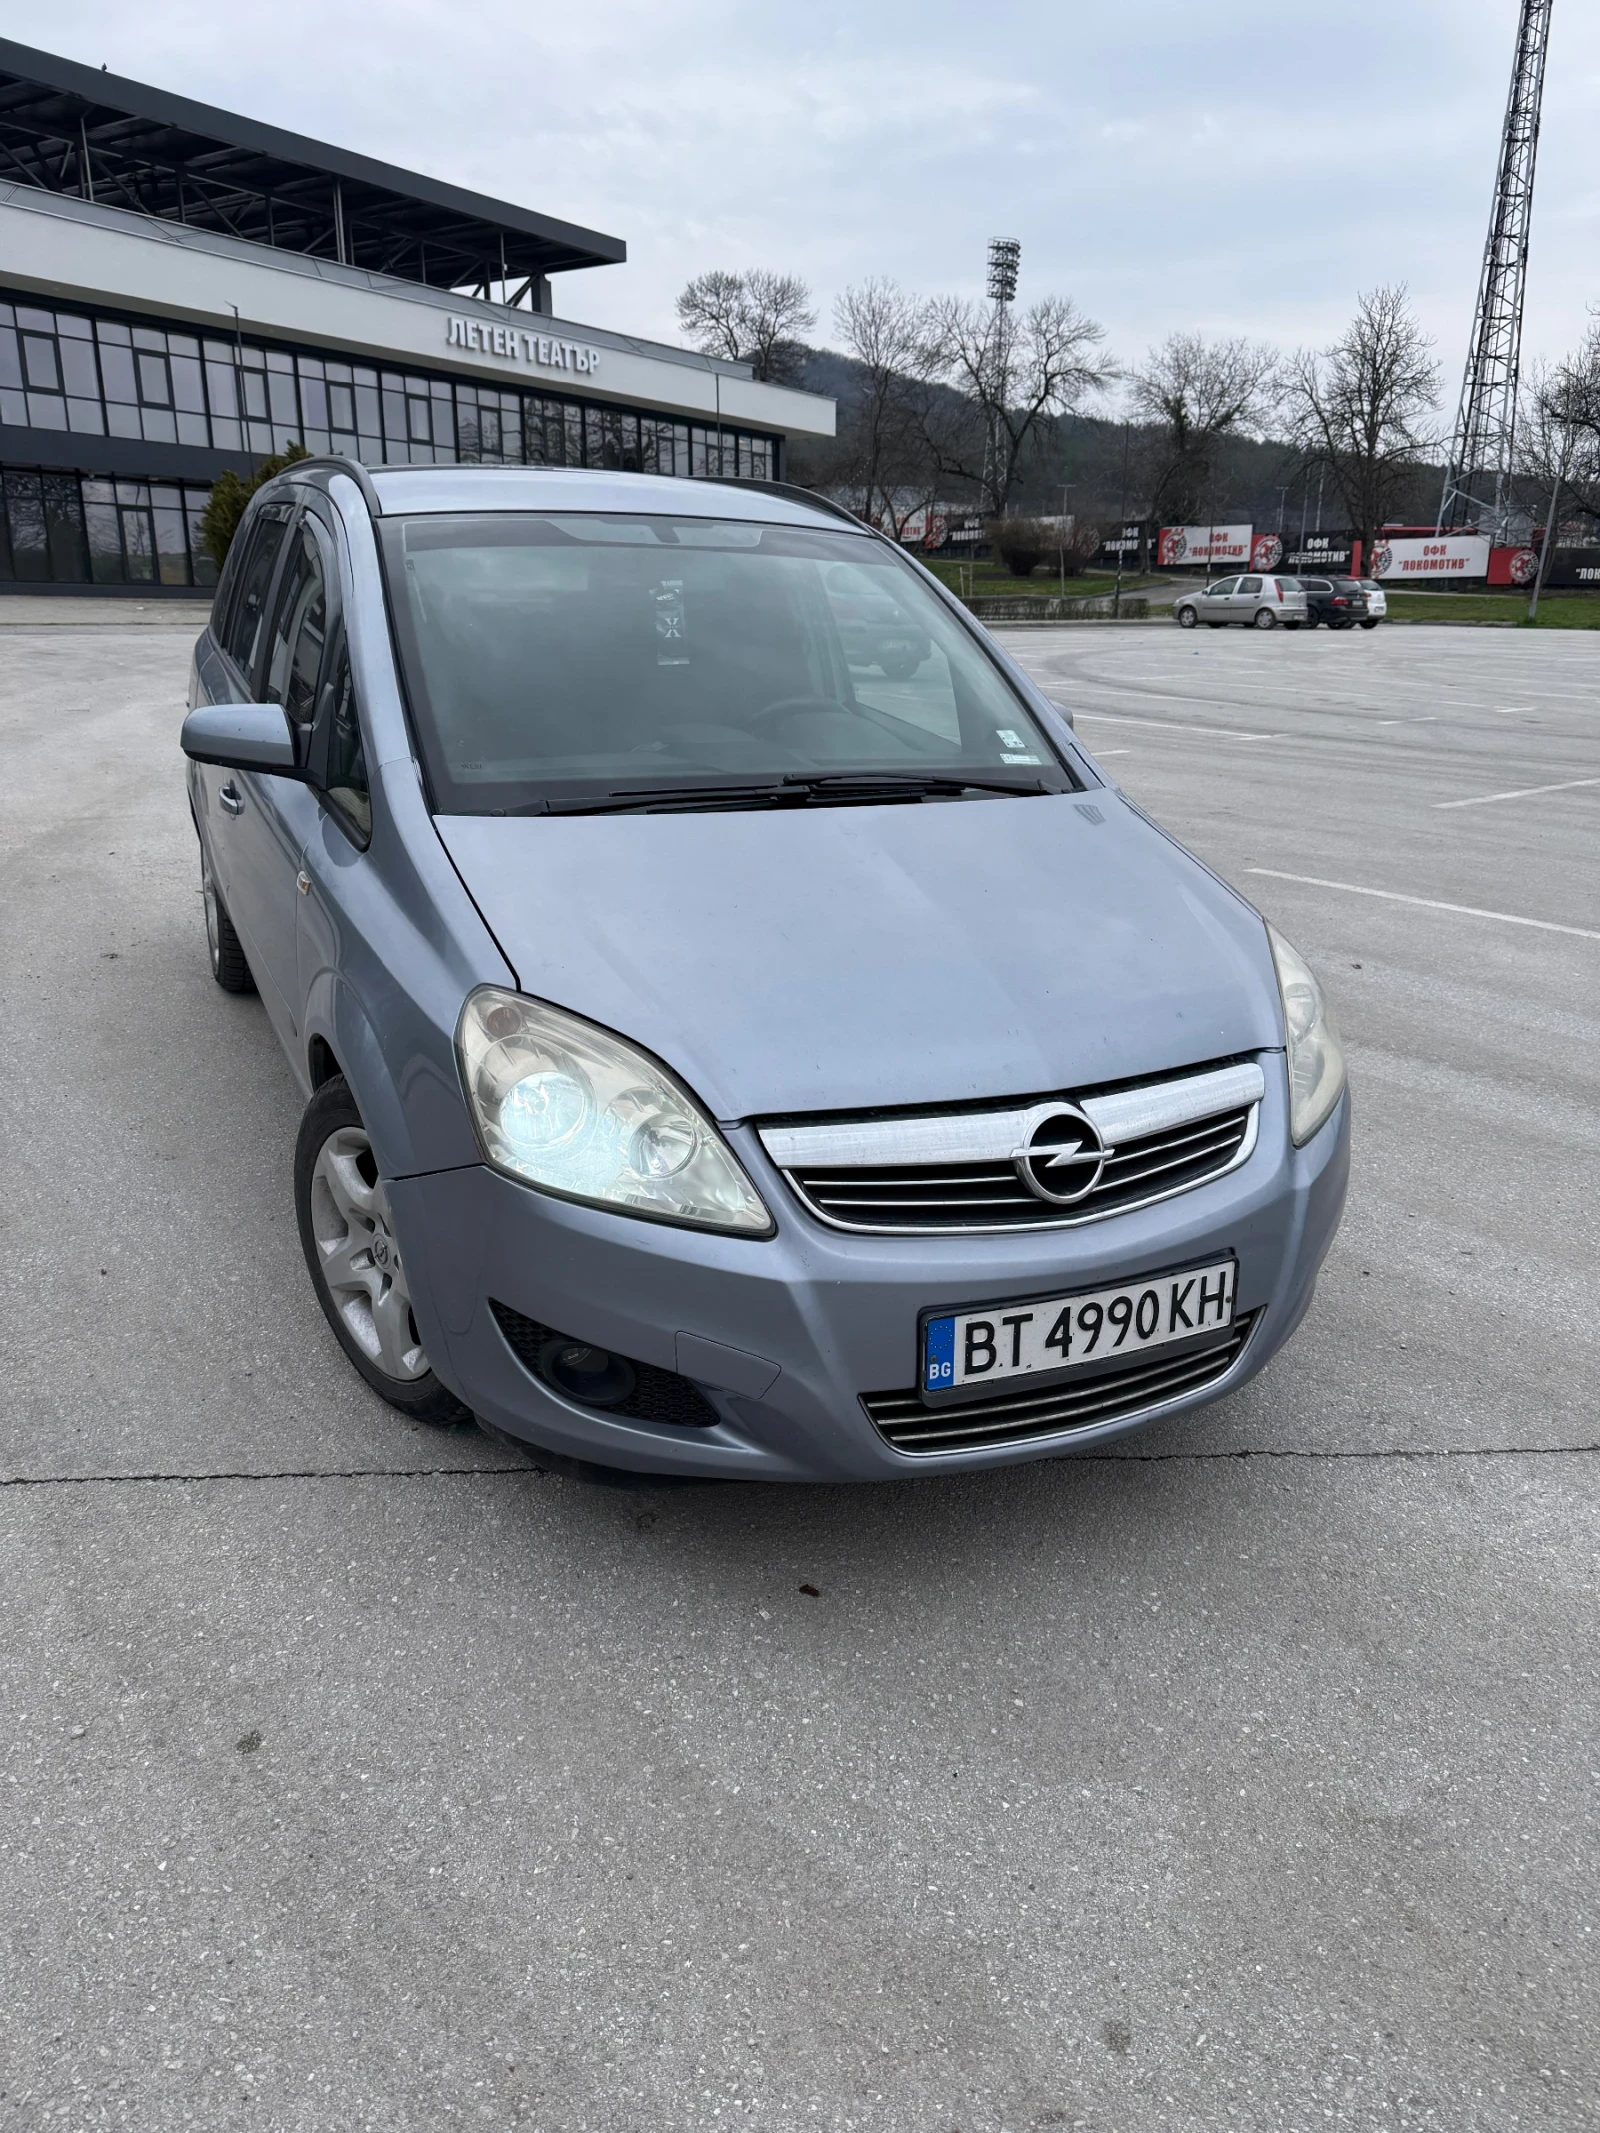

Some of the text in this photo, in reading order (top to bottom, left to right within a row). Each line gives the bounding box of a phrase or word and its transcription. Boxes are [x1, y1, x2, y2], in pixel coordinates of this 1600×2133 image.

[448, 317, 600, 375] ЛЕТЕН ТЕАТЪР
[1306, 537, 1330, 549] ОФК
[1423, 544, 1447, 556] ОФК
[964, 1271, 1227, 1376] BT 4990 KH
[929, 1363, 951, 1381] BG
